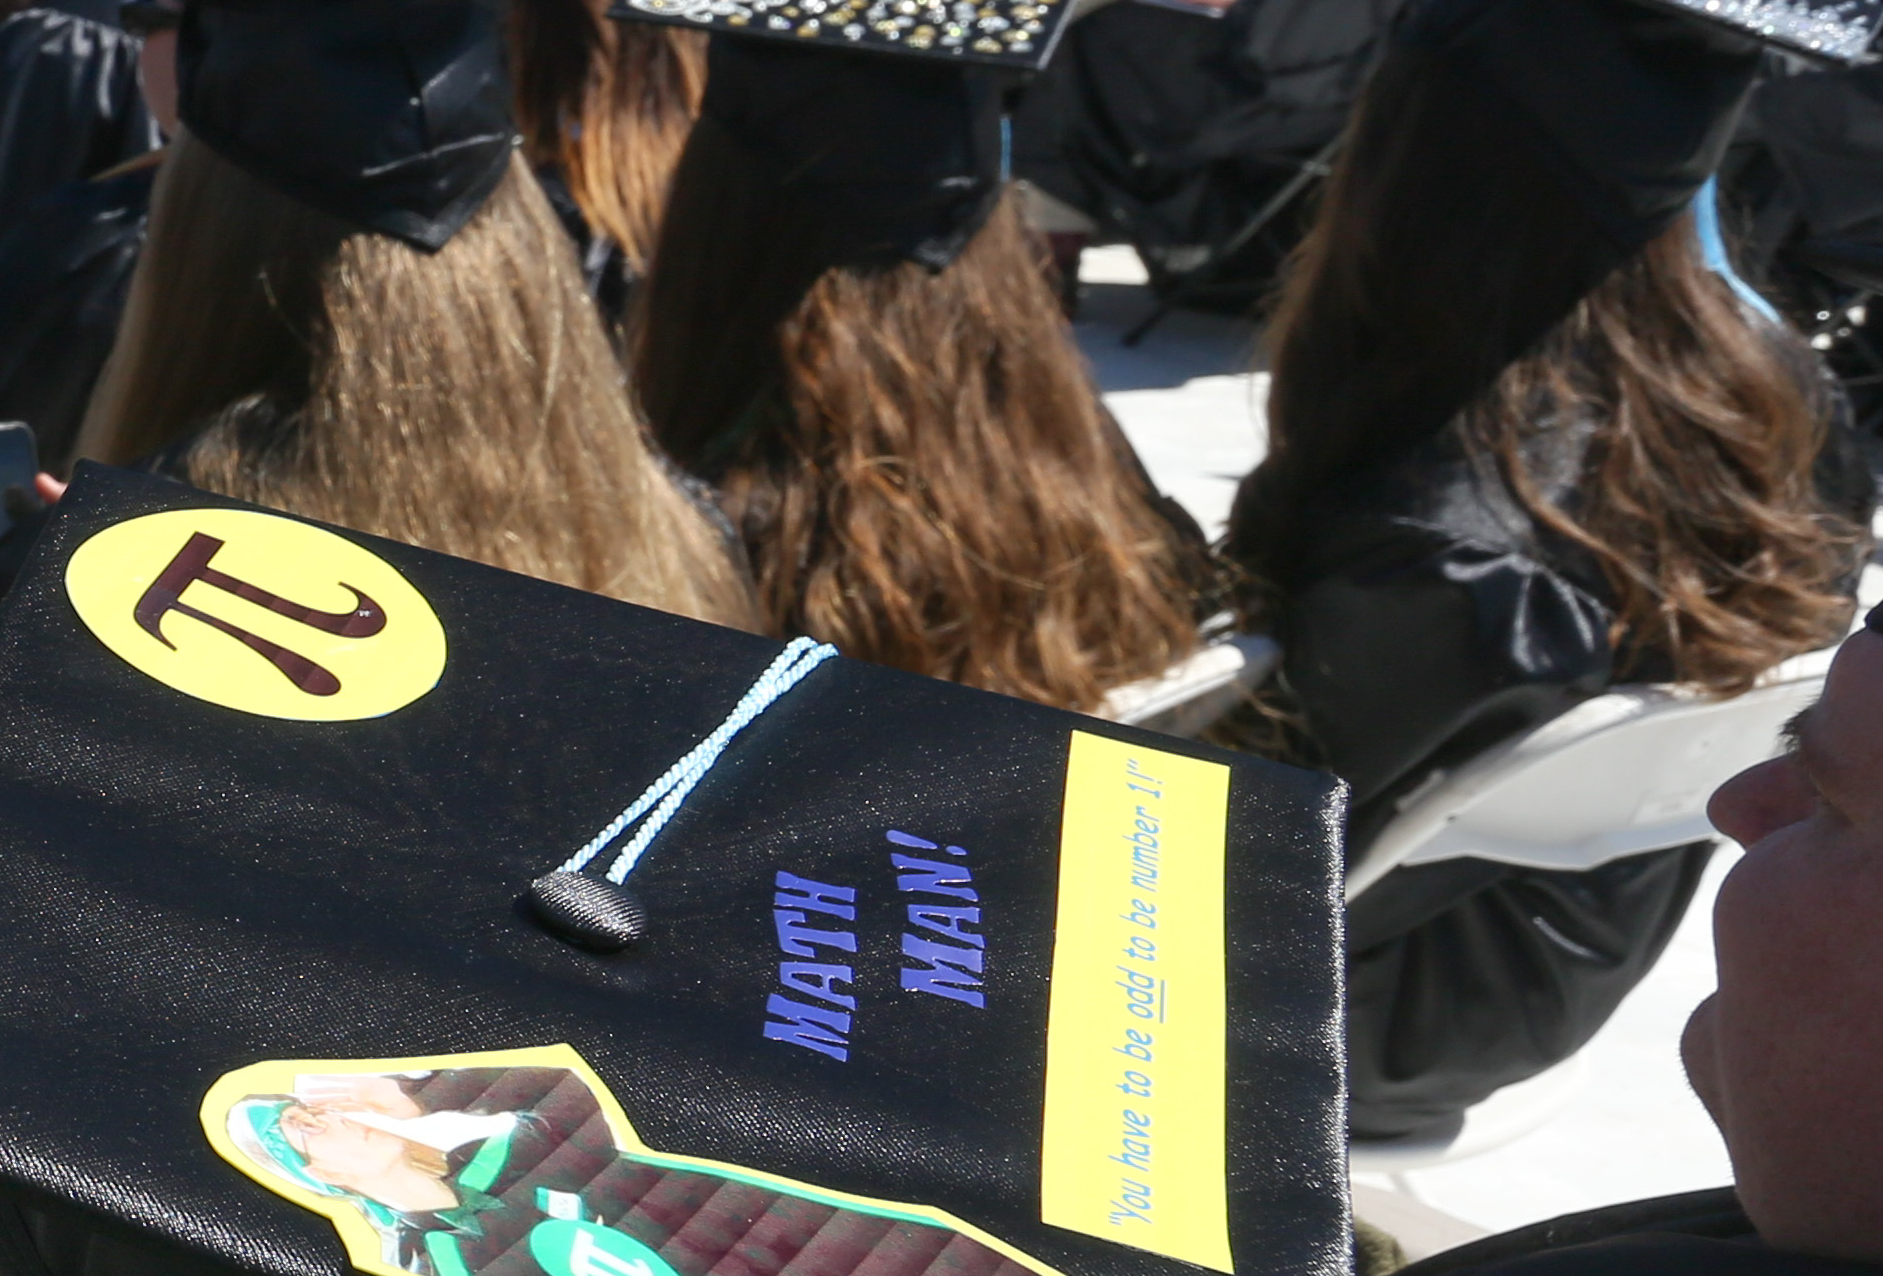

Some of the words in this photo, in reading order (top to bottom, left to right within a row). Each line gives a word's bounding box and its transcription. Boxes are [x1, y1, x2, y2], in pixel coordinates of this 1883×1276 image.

[1121, 805, 1160, 893] number
[886, 829, 986, 1010] MAN!
[1118, 898, 1158, 930] be
[763, 870, 857, 1063] MATH
[1122, 935, 1157, 962] to
[1114, 964, 1156, 1020] odd
[1111, 1028, 1153, 1063] be
[1115, 1070, 1152, 1098] to
[1107, 1109, 1151, 1172] have
